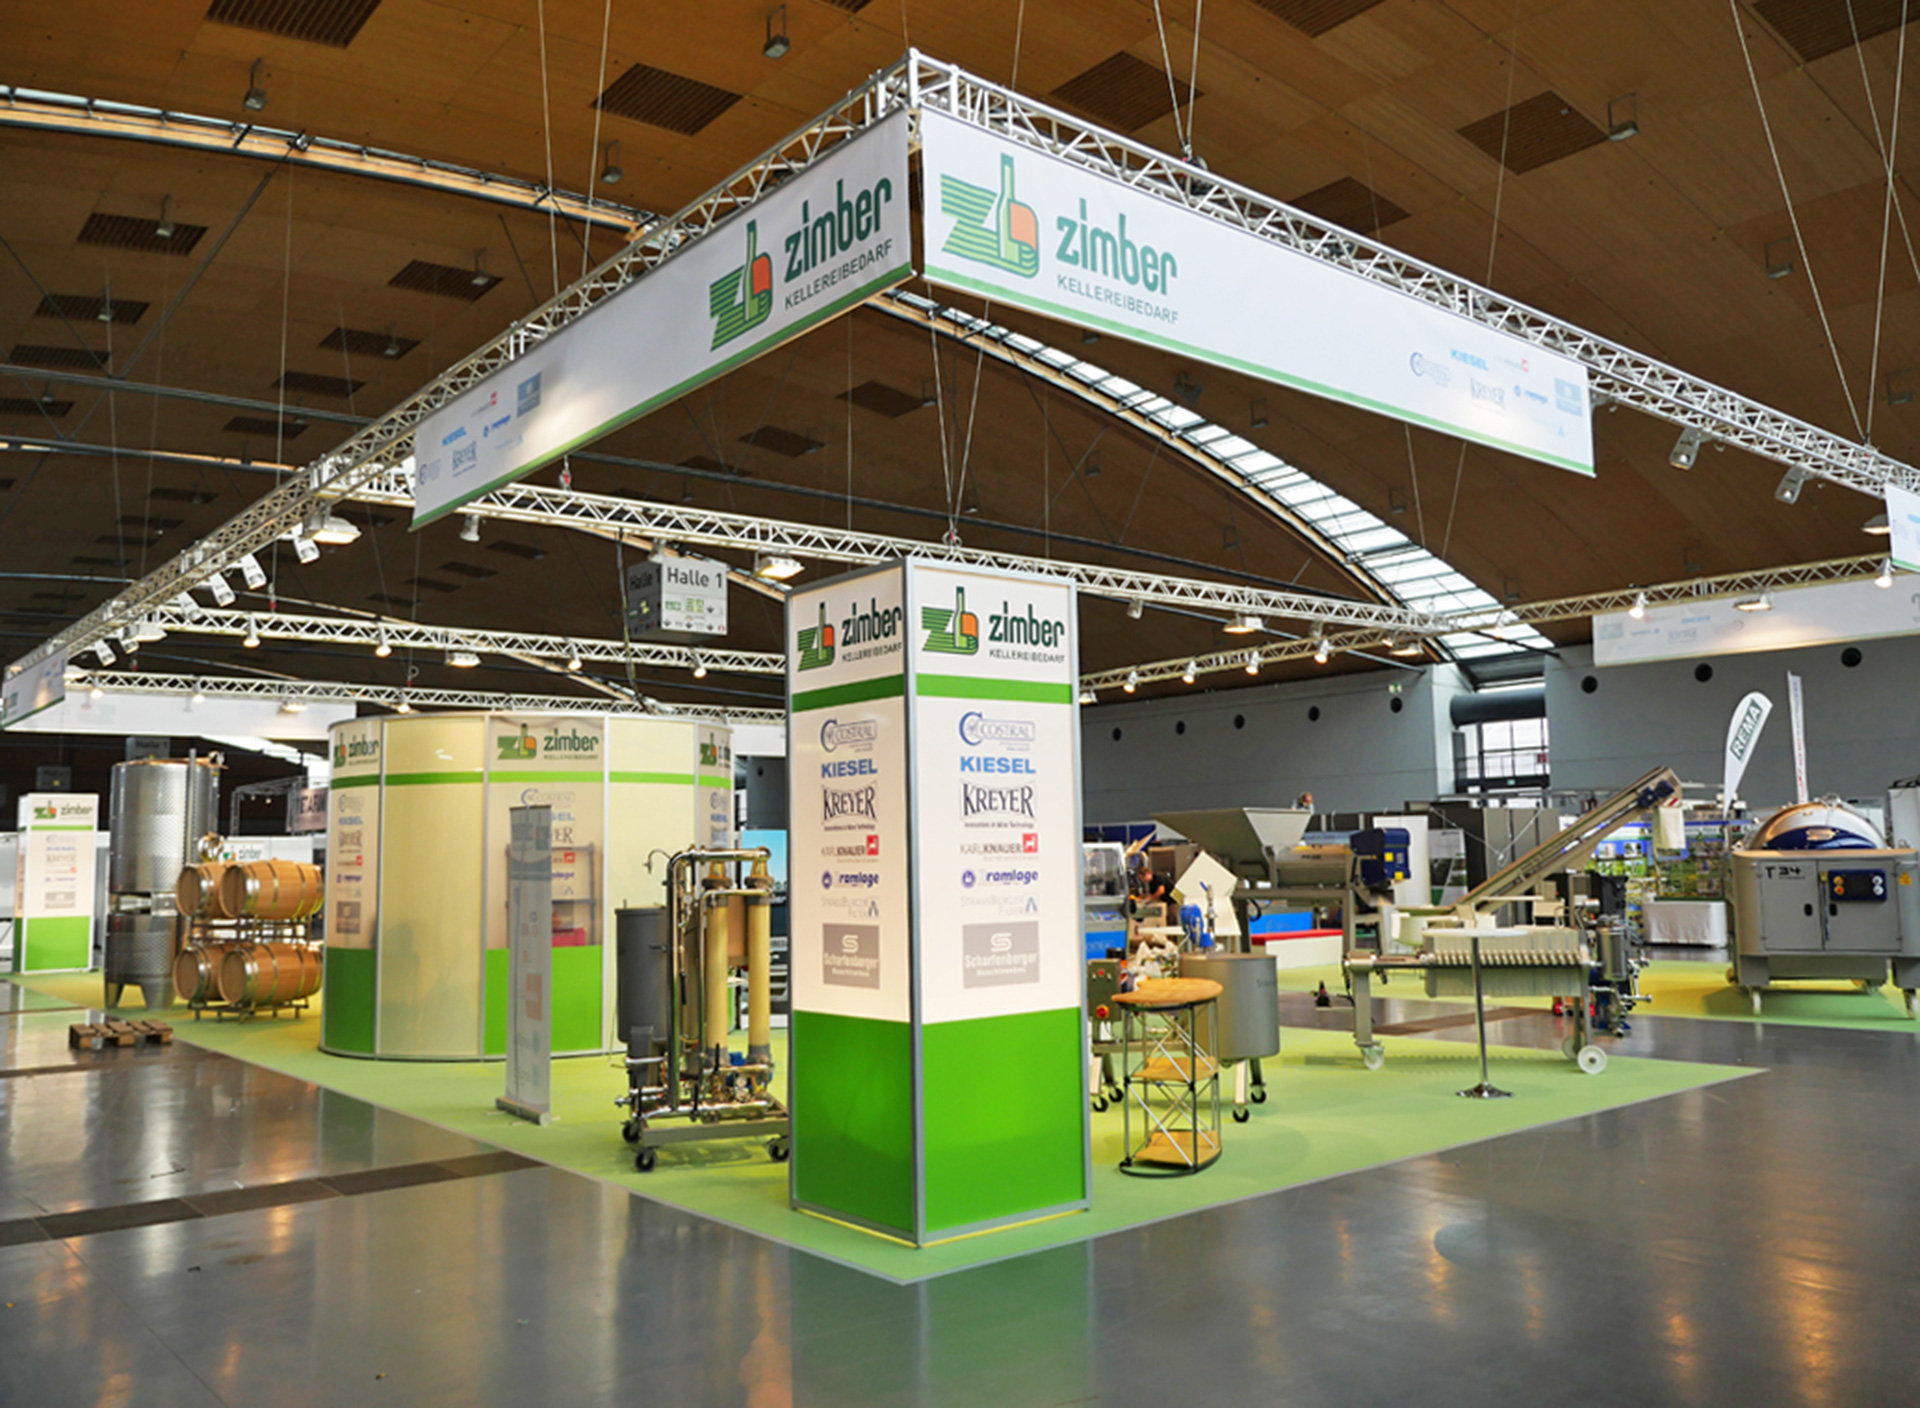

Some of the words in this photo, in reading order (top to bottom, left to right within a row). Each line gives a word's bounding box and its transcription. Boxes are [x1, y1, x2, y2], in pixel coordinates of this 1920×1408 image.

[785, 177, 892, 283] zimber
[1056, 197, 1177, 296] zimber
[785, 238, 892, 310] KELLEREIBEDARF
[1057, 274, 1179, 324] KELLEREIBEDARF
[667, 566, 709, 588] Halle
[715, 572, 722, 588] 1
[842, 598, 902, 647] zimber
[988, 601, 1065, 647] zimber
[989, 649, 1065, 663] KELLEREIBEDARF
[543, 728, 599, 752] zimber
[1731, 704, 1763, 759] REMA
[821, 758, 878, 779] KIESEL
[960, 756, 1036, 774] KIESEL
[823, 784, 876, 820] KREYER
[963, 783, 1034, 818] KREYER
[1766, 866, 1775, 879] T
[1779, 866, 1801, 876] 34
